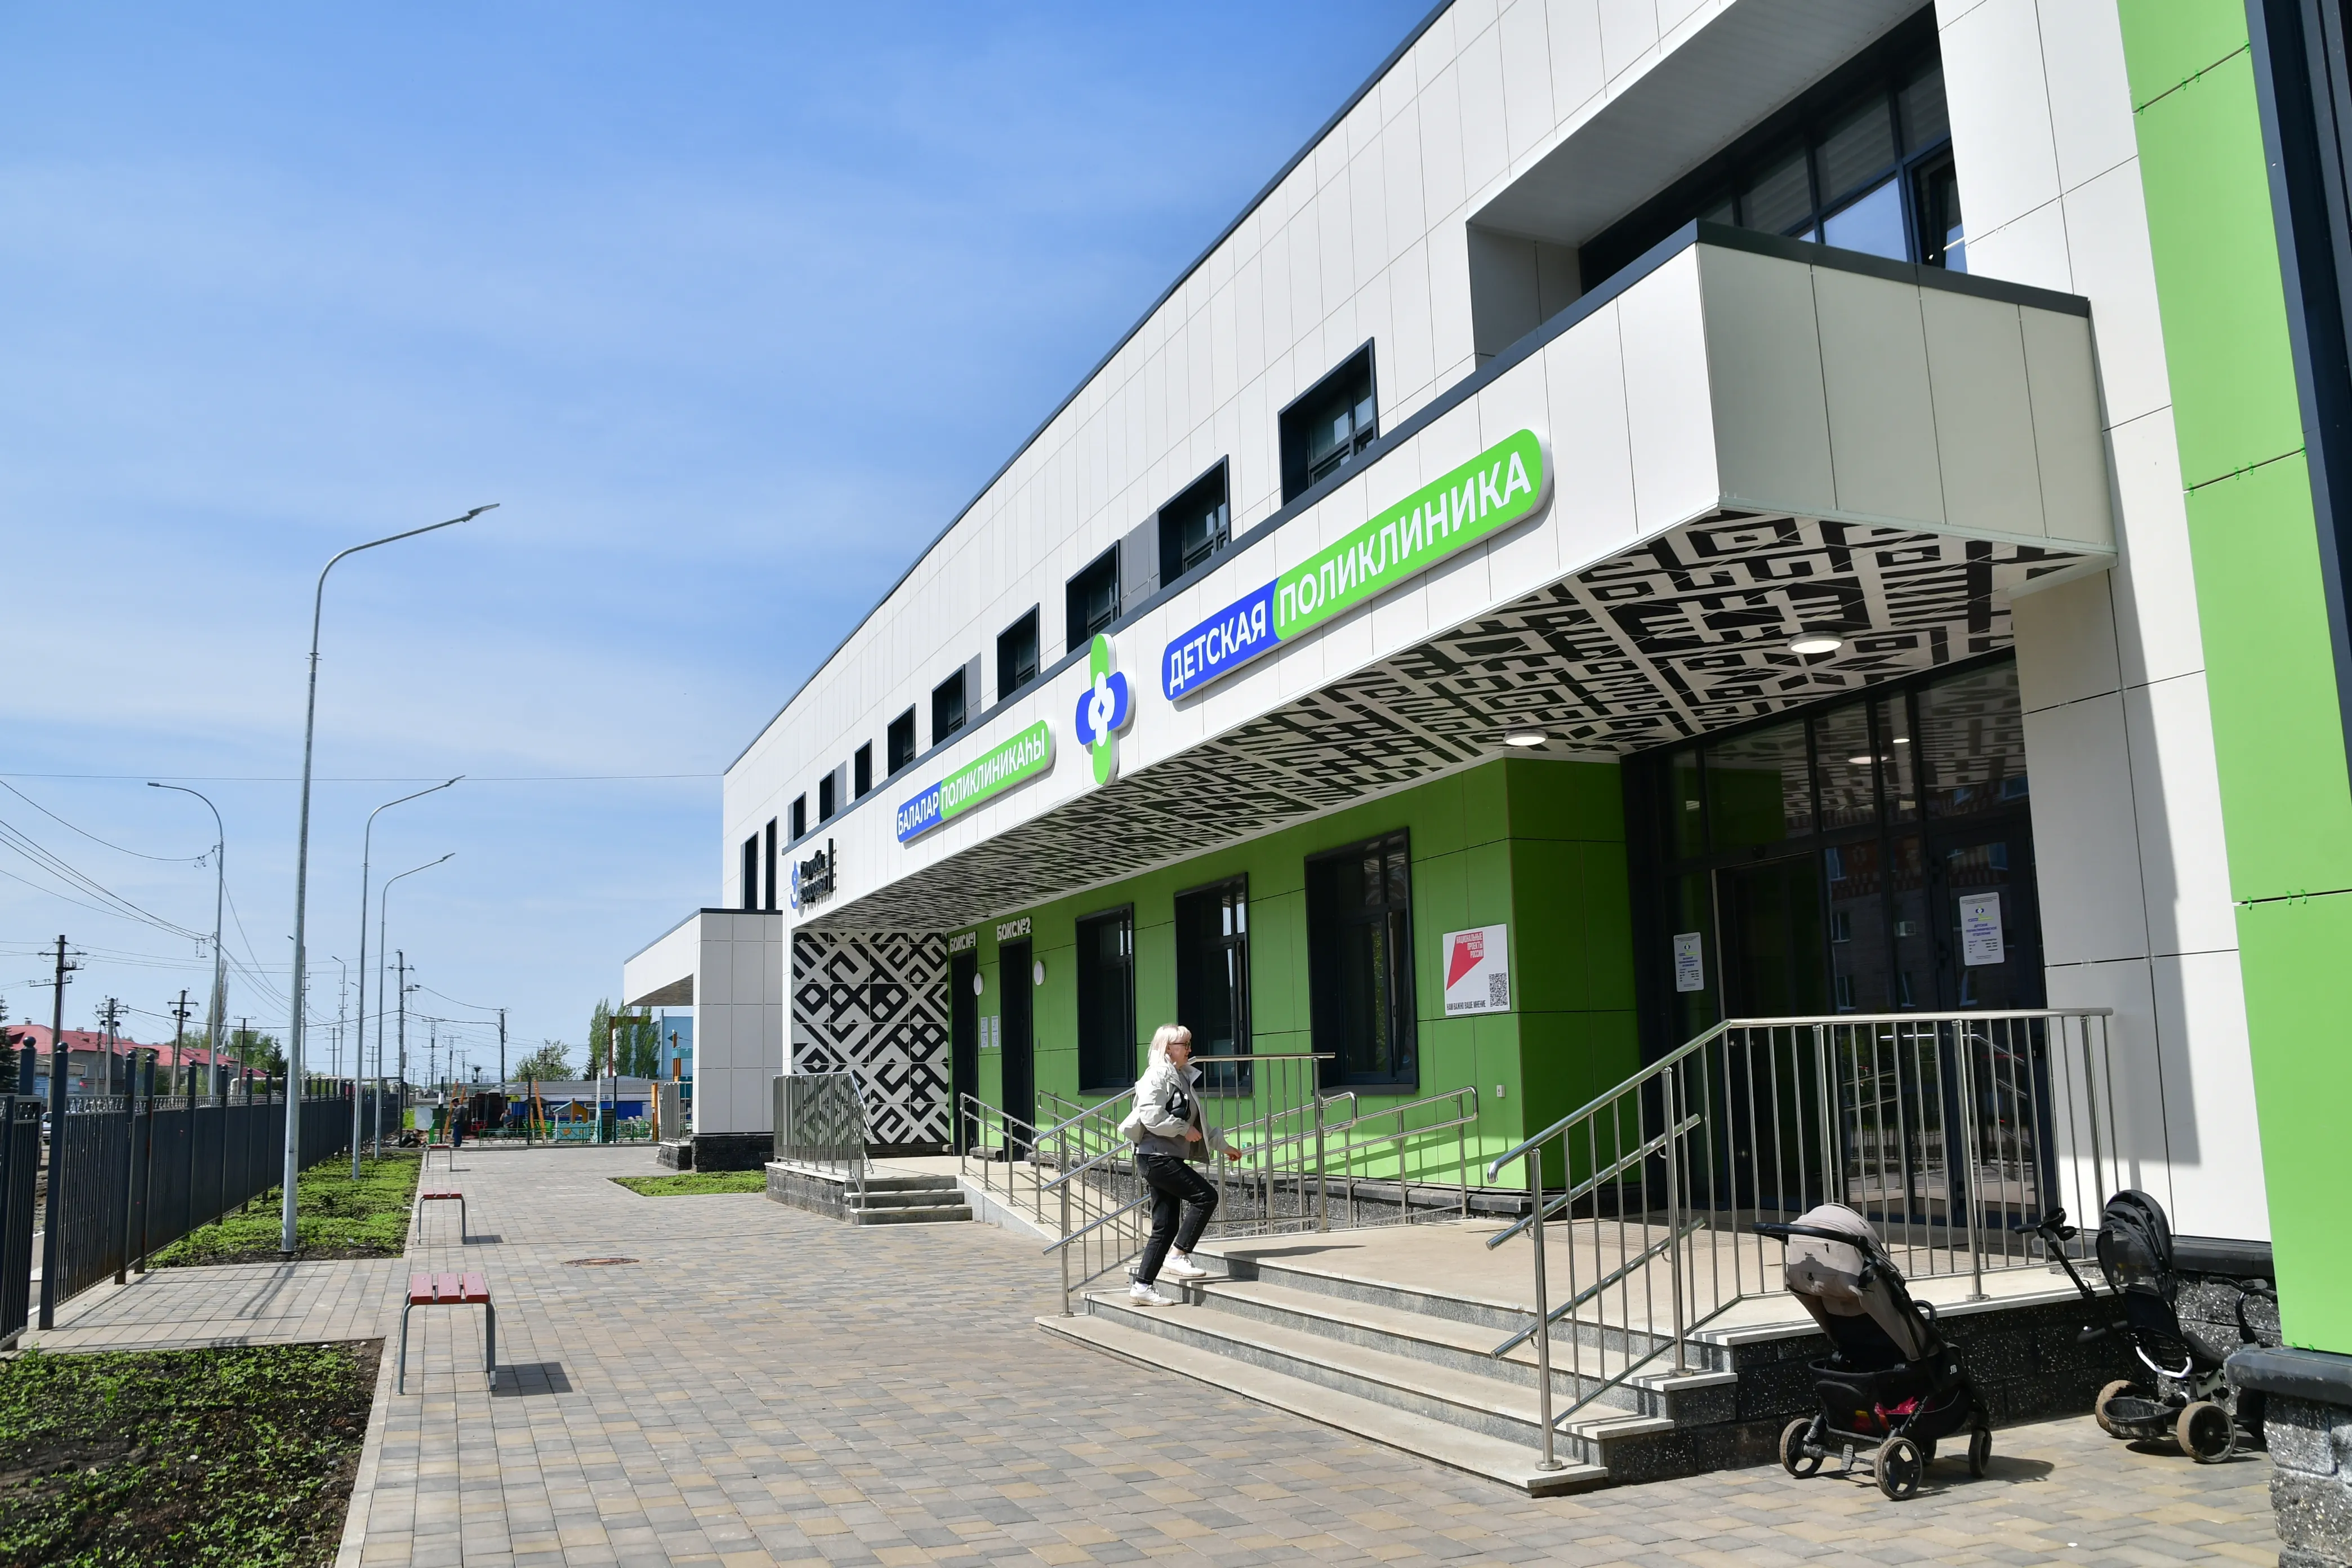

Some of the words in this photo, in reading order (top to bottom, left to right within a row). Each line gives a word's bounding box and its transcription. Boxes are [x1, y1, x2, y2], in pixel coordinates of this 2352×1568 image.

[1169, 600, 1267, 694] ДЕТСКАЯ
[1279, 451, 1532, 627] ПОЛИКЛИНИКА
[898, 791, 939, 835] БАЛАЛАР
[1456, 933, 1483, 945] НАЦИОНАЛЬНЫЕ
[1467, 941, 1483, 951] ПРОЕКТЫ
[1470, 950, 1483, 959] РОССИИ
[1473, 1000, 1486, 1008] МНЕНИЕ
